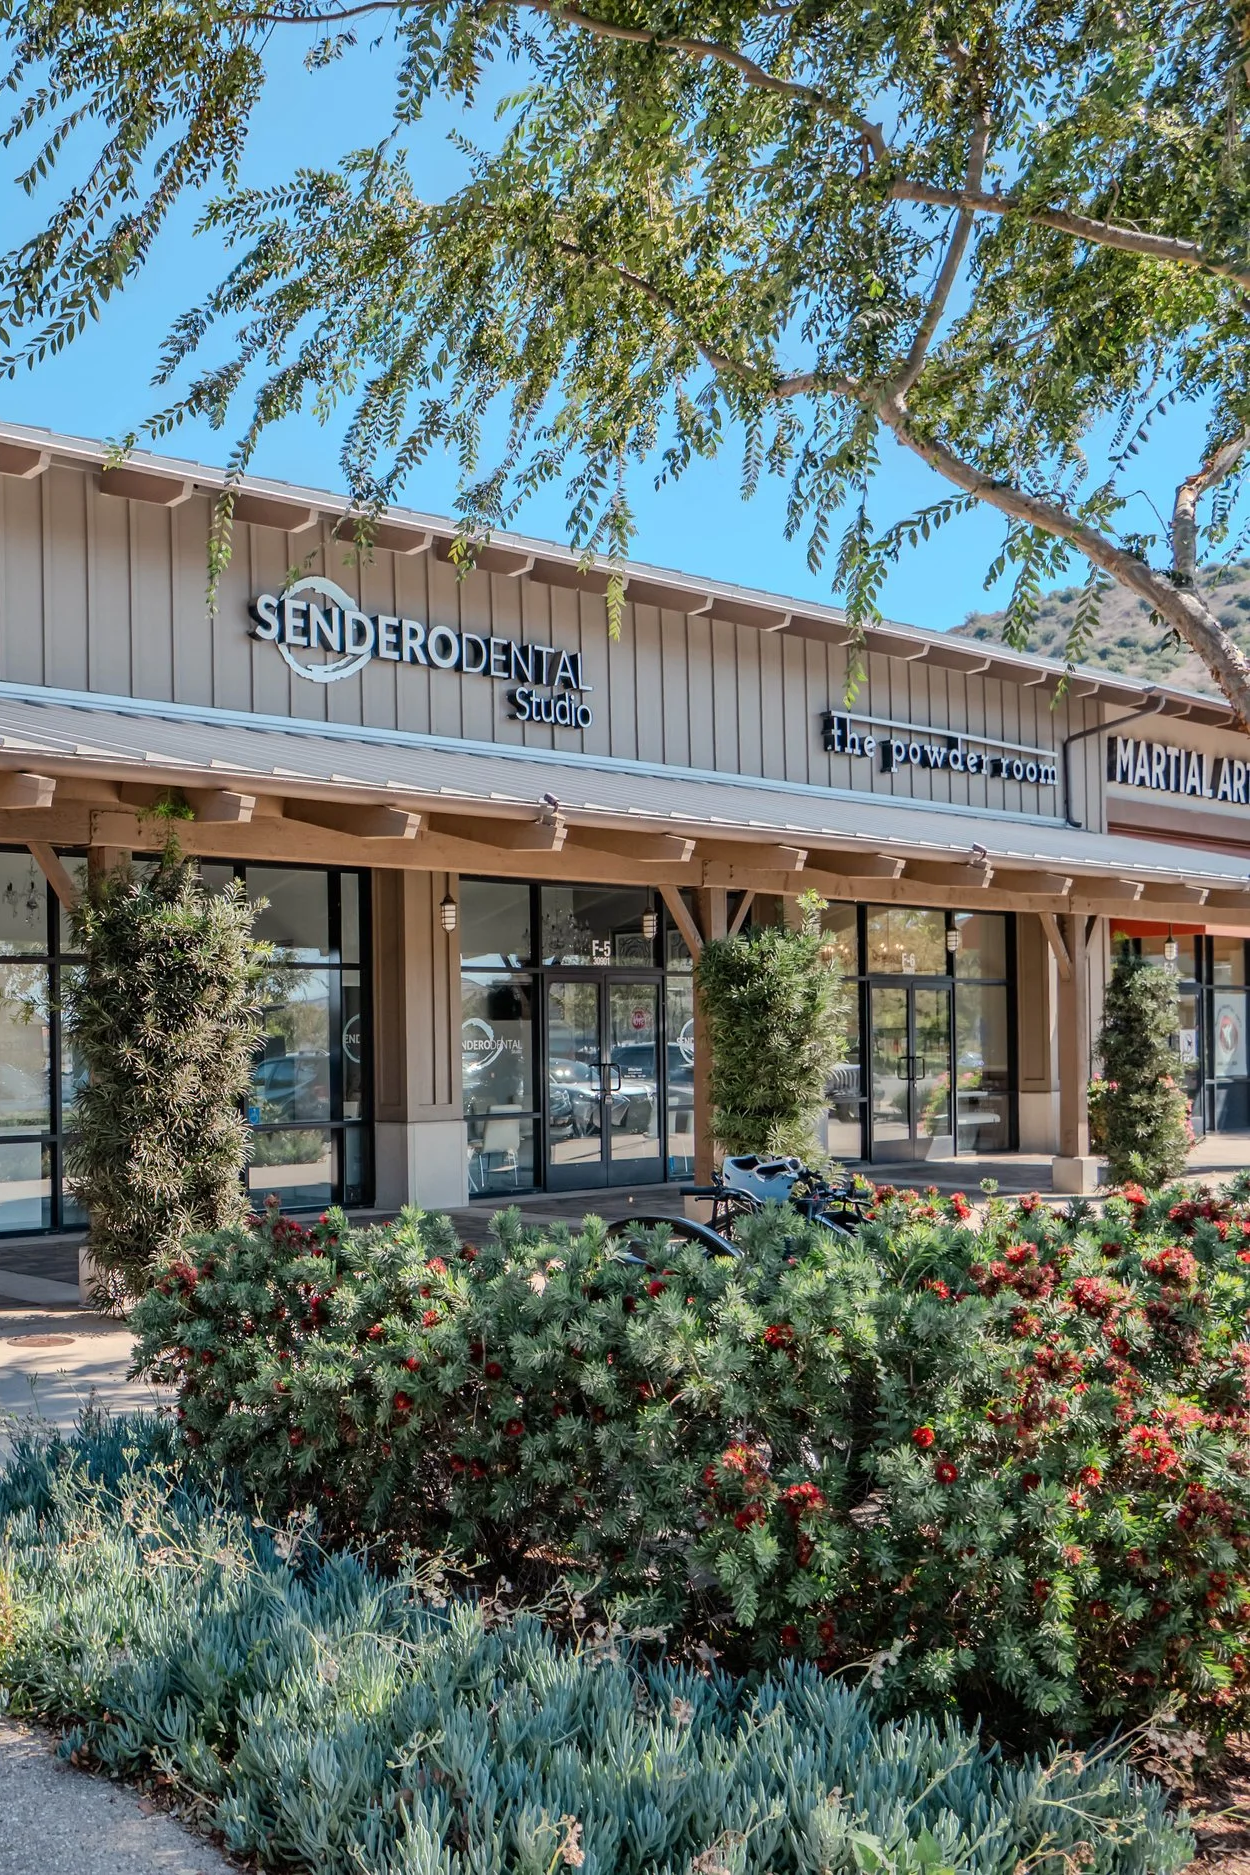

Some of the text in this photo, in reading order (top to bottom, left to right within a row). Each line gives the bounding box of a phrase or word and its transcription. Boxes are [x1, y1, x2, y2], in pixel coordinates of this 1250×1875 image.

[513, 685, 594, 730] Studio
[829, 715, 1059, 786] the powder room
[1115, 736, 1214, 799] MARTIAL
[592, 939, 611, 957] F-5
[901, 952, 916, 967] F-6
